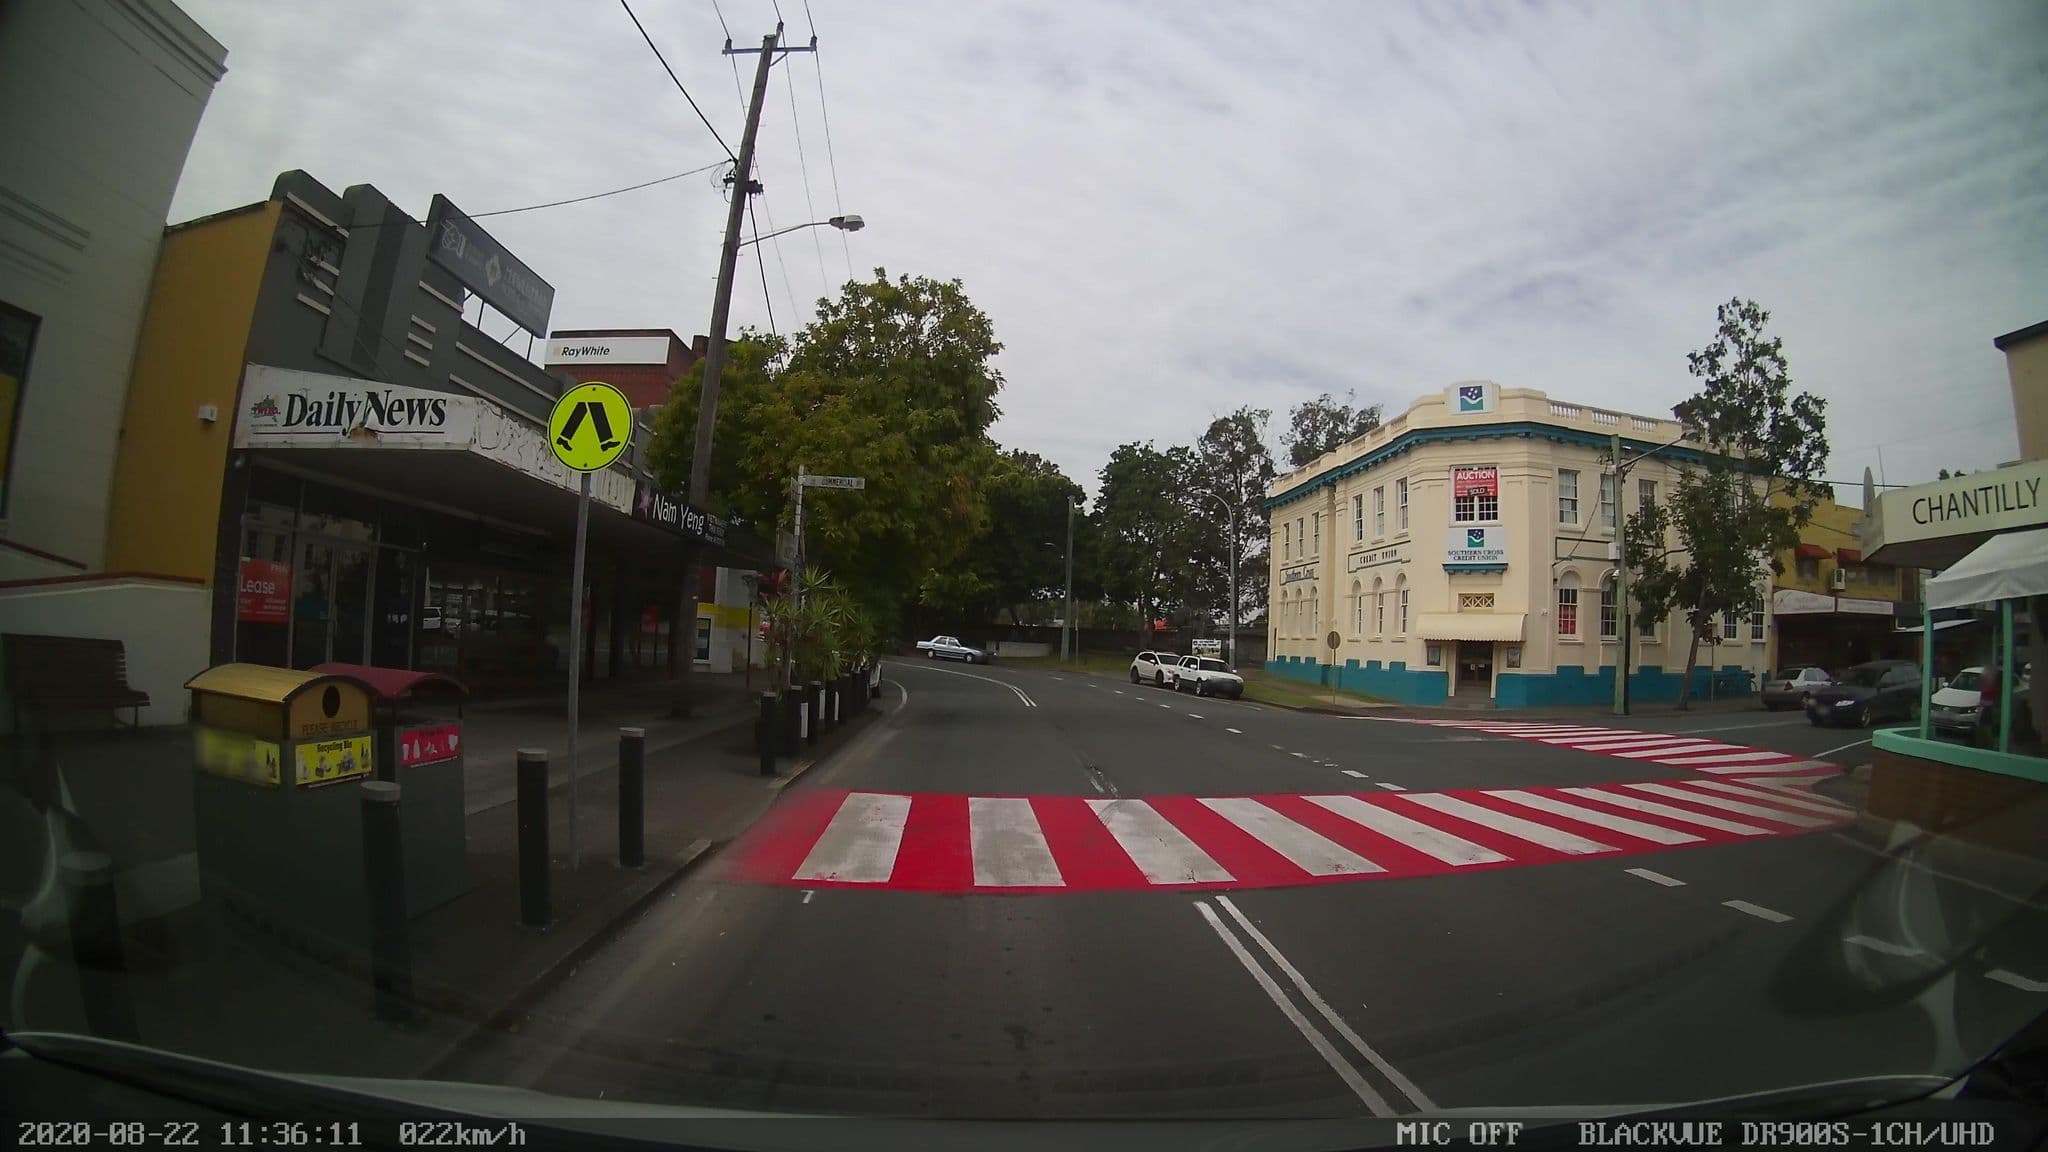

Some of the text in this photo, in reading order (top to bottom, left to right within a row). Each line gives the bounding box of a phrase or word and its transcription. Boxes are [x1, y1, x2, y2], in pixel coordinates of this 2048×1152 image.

[282, 390, 448, 438] Daily News
[1456, 470, 1495, 480] AUCTION
[652, 492, 677, 524] Nam
[680, 504, 704, 535] Yeng
[1912, 477, 2041, 525] CHANTILLY
[240, 576, 275, 594] Lease
